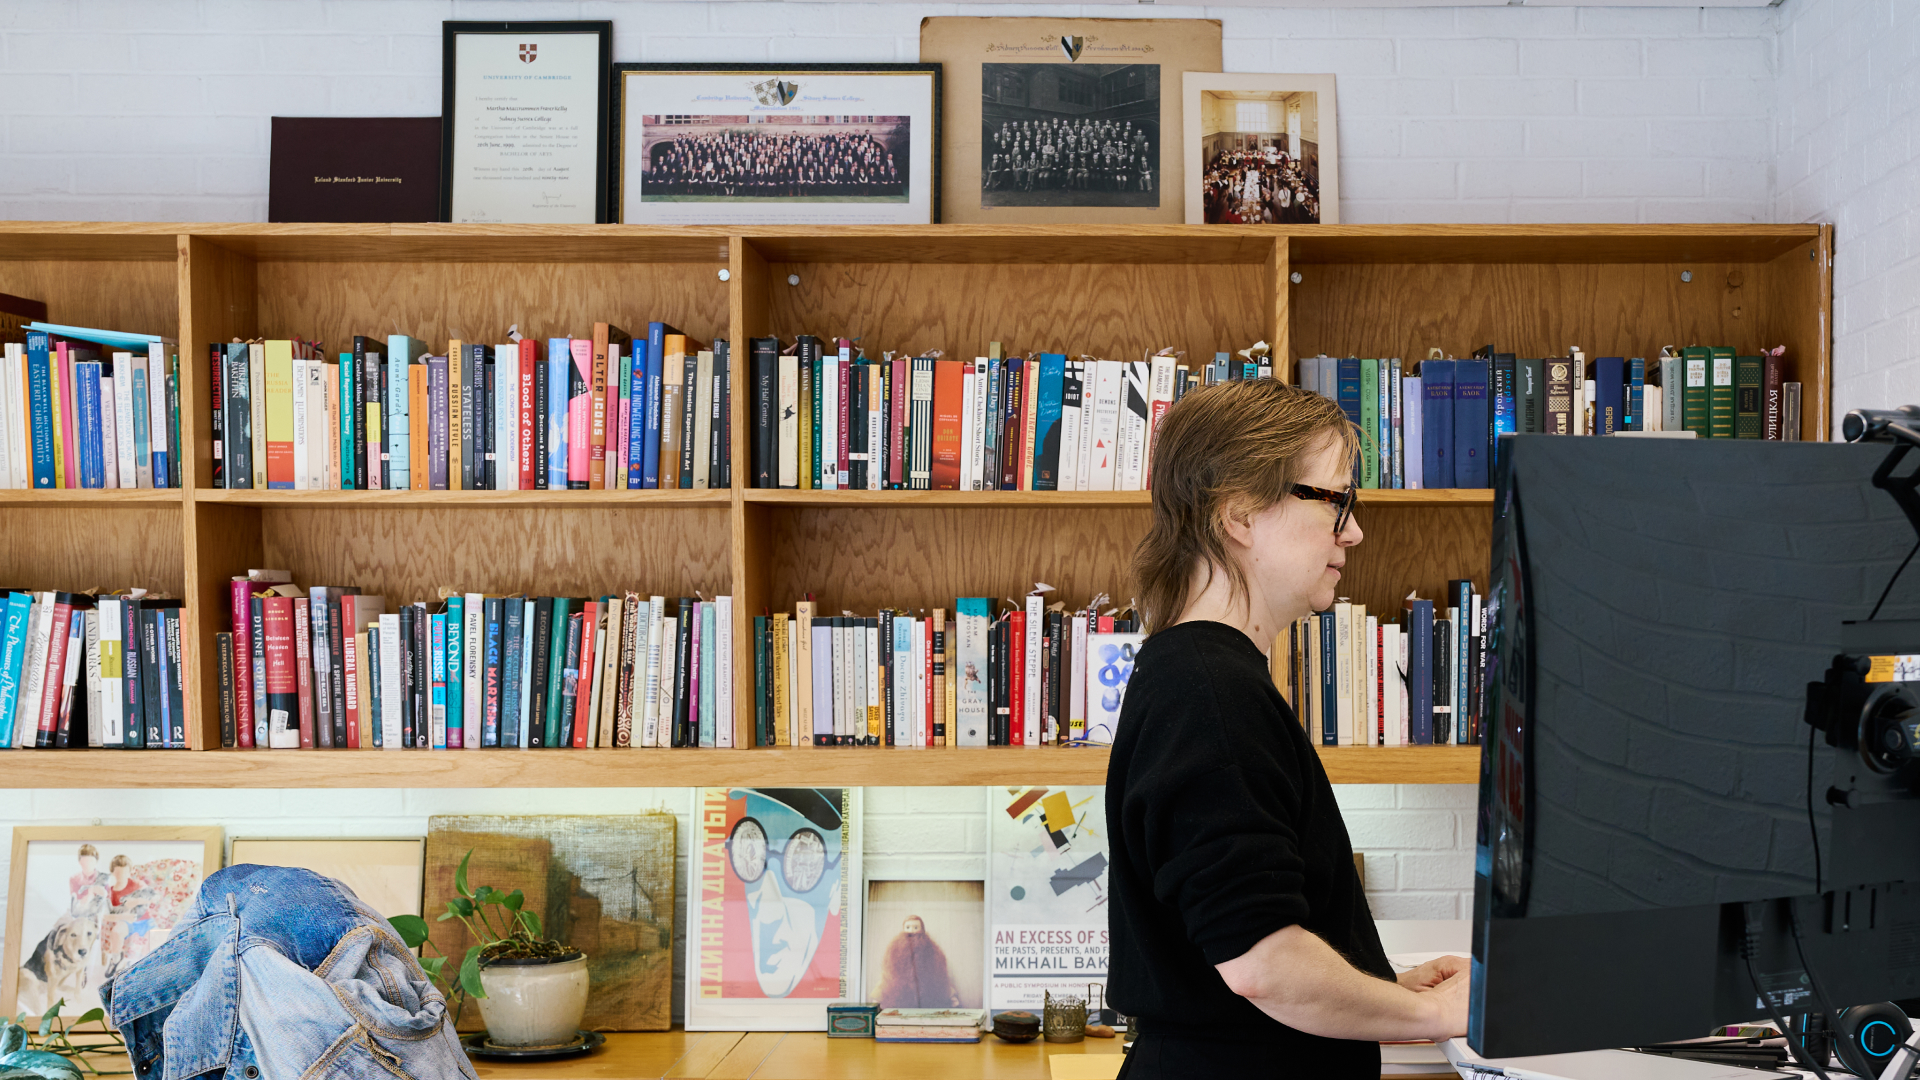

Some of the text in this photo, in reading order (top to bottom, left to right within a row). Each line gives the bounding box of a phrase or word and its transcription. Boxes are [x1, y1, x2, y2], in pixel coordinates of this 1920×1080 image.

[212, 351, 221, 409] RESURRECTION
[238, 362, 246, 398] MIKHAIL
[761, 375, 769, 387] My
[977, 377, 985, 395] Anton
[991, 360, 999, 379] Night
[1504, 369, 1513, 403] joseph
[594, 354, 604, 436] ALTER ICONS
[686, 386, 694, 409] Russian
[976, 396, 984, 426] Chekhov's
[1495, 369, 1504, 415] бродский
[439, 411, 444, 419] OF
[463, 385, 471, 440] STATELESS
[522, 373, 531, 472] Blood of Others
[631, 380, 642, 461] AN INDWELLING VOICE
[761, 402, 769, 428] Century
[1768, 389, 1778, 440] УЛИЦКАЯ
[9, 611, 22, 634] The
[434, 621, 443, 651] PUTIN'S
[1028, 601, 1038, 678] THE SILENT STEPPE
[3, 636, 21, 670] Pleasures
[253, 616, 264, 701] DIVINE SOPHIA
[448, 623, 459, 672] BEYOND
[536, 611, 547, 686] RECORDING RUSSIA
[567, 621, 577, 667] Orientalism
[41, 621, 65, 726] Reimagining Denominationalism
[127, 651, 137, 678] RUSSIAN
[235, 623, 247, 729] PICTURING RUSSIA
[345, 637, 356, 709] ILLIBERAL VANGUARD
[486, 623, 498, 726] BLACK MARXISM
[926, 659, 931, 668] Ra
[0, 680, 14, 720] Philosophy
[512, 681, 519, 689] IN
[896, 655, 907, 722] Doctor Zhivago
[841, 820, 849, 850] ОПЕРАТОР
[700, 787, 727, 998] ОДИННАДЦАТЫЙ
[995, 931, 1014, 944] AN
[1020, 931, 1072, 944] EXCESS
[1077, 931, 1095, 944] OF
[1012, 947, 1038, 955] PASTS,
[1040, 947, 1081, 955] PRESENTS,
[996, 957, 1108, 969] MIKHAIL BAK
